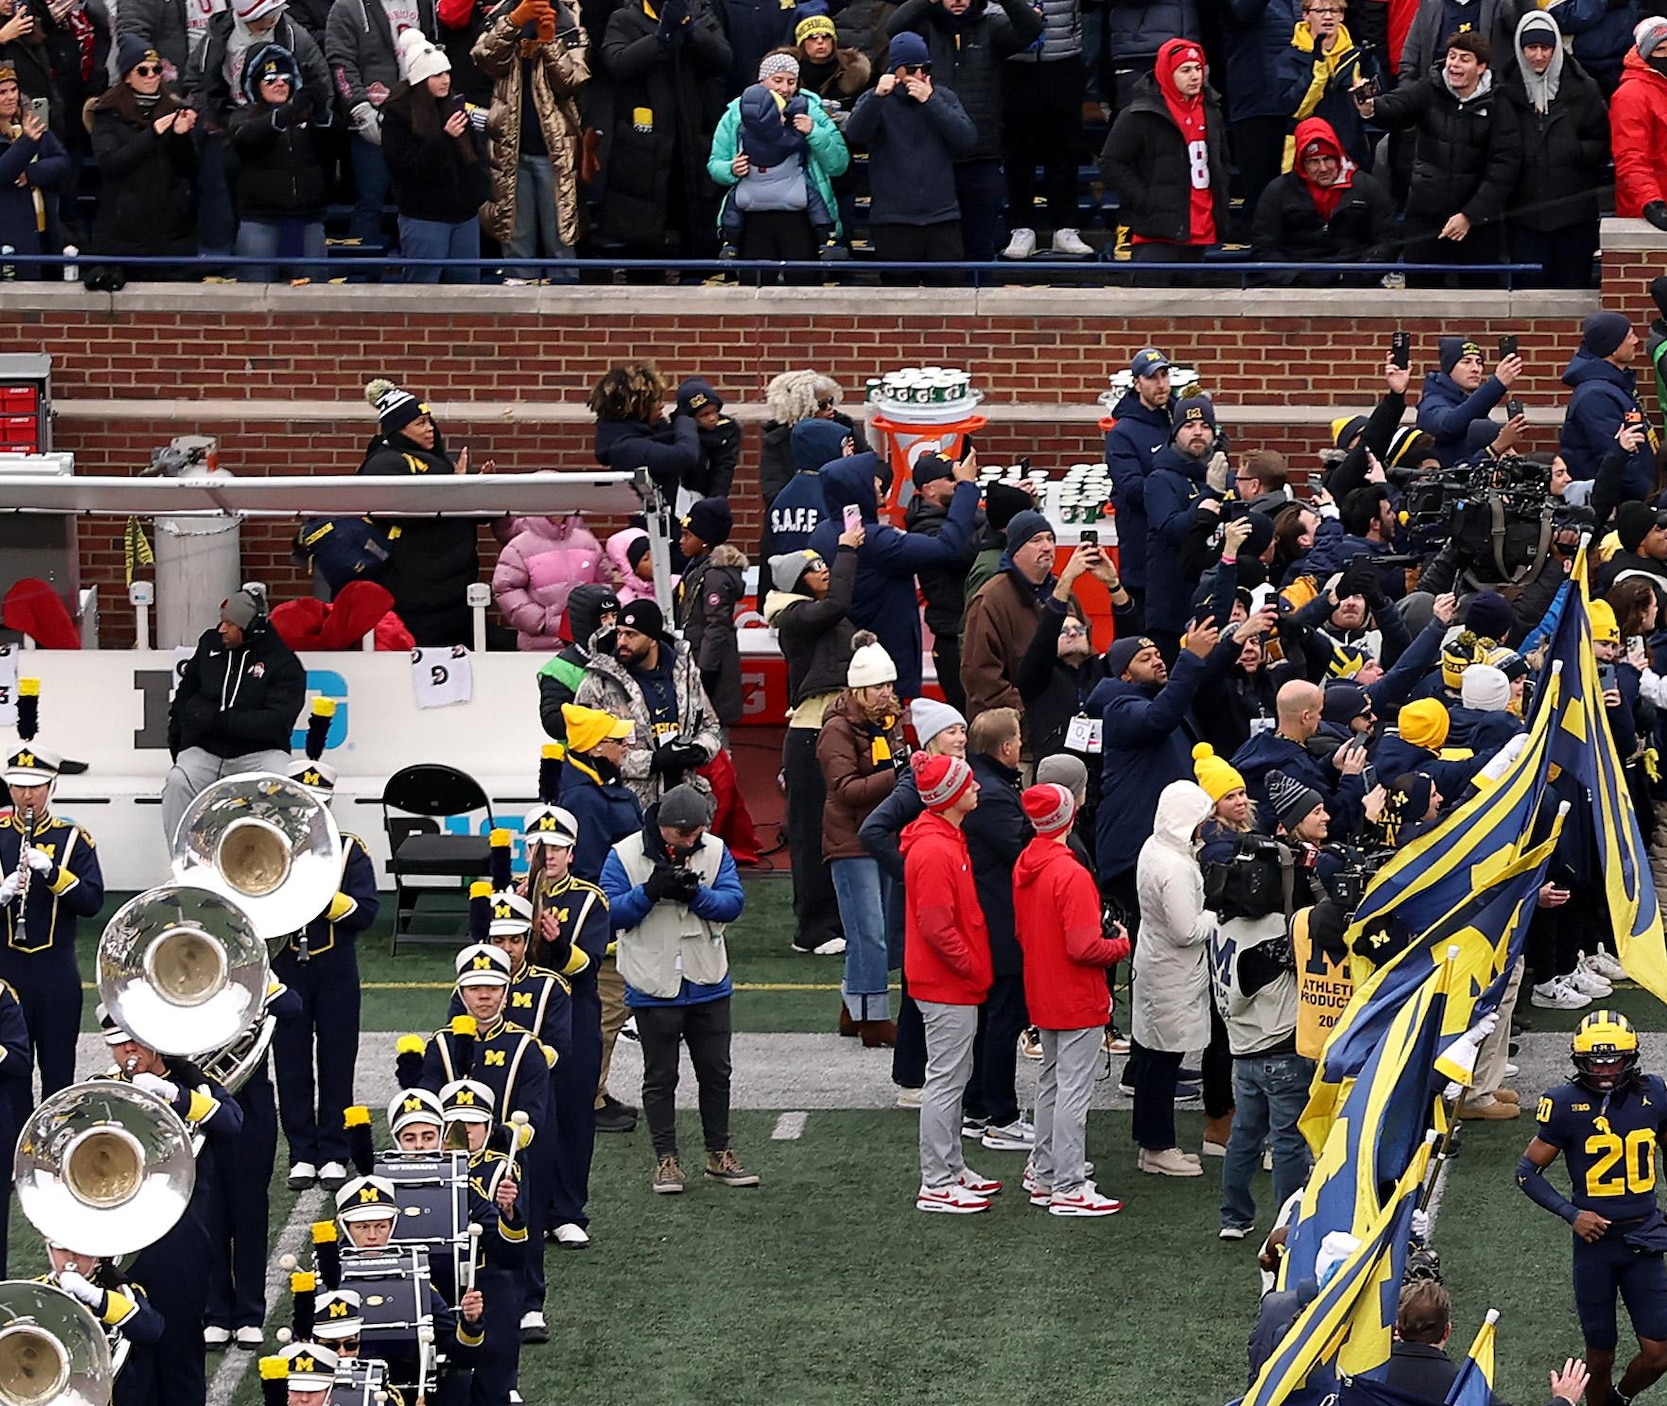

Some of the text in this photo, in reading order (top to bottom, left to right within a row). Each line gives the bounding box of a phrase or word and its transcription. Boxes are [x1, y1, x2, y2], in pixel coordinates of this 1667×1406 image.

[1188, 141, 1210, 189] 8
[1370, 930, 1390, 948] M
[472, 956, 492, 971] M
[1302, 979, 1354, 996] ATHLETI
[1301, 991, 1350, 1009] PRODUCT
[484, 1051, 506, 1066] M
[402, 1098, 423, 1113] M
[1584, 1128, 1656, 1197] 20
[358, 1188, 380, 1203] M
[294, 1356, 315, 1373] M
